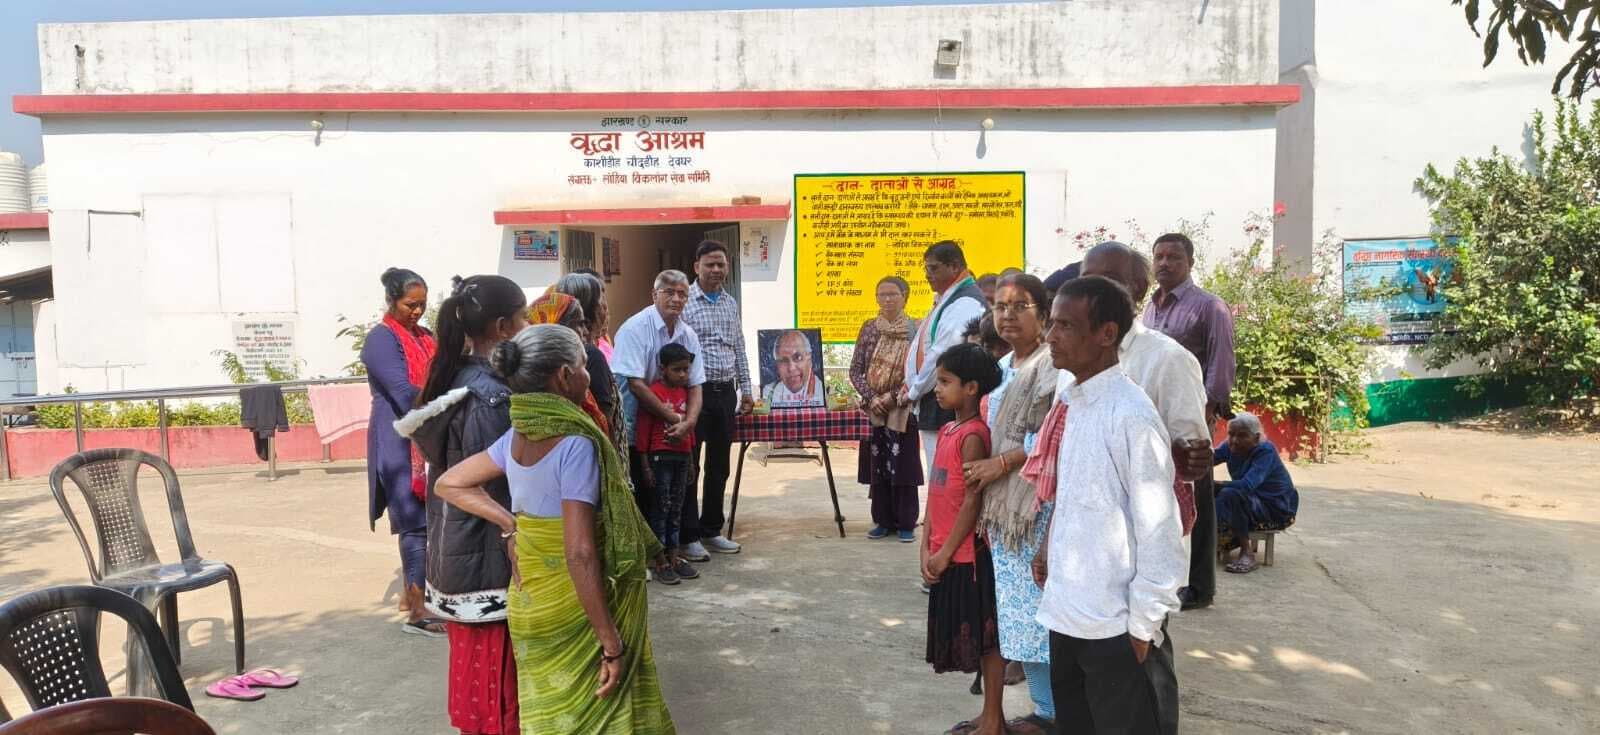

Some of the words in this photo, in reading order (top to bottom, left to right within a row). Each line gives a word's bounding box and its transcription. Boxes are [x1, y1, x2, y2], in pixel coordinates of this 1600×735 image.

[601, 117, 634, 127] झारखण्ड
[635, 130, 705, 152] आश्रम
[668, 156, 693, 169] देवघर
[670, 171, 684, 184] सेवा
[687, 170, 710, 183] समिति
[912, 176, 923, 190] से
[928, 177, 956, 190] आग्रह
